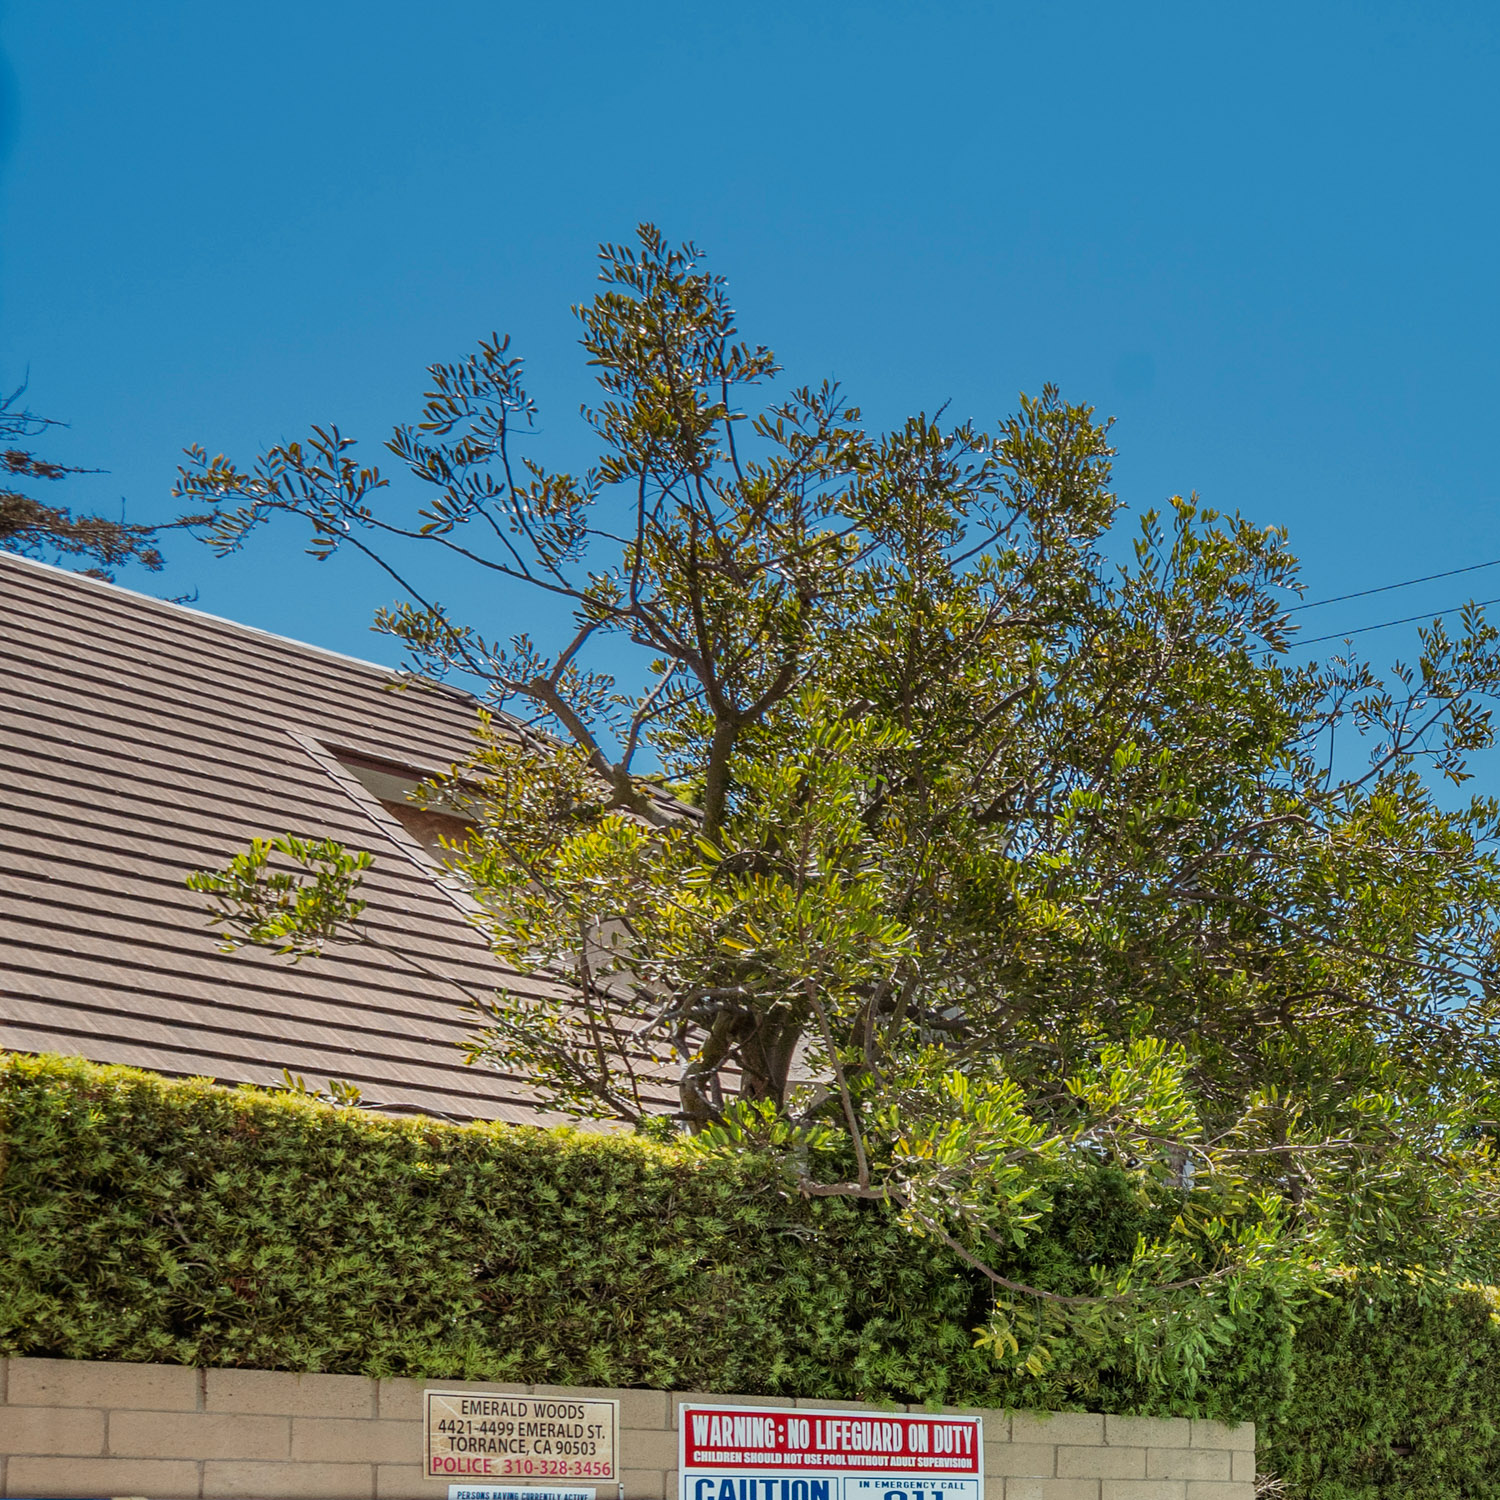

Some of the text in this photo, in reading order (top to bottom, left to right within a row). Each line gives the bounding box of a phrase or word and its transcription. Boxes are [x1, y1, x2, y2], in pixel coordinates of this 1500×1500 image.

[461, 1399, 585, 1420] EMERALD WOODS
[438, 1419, 606, 1440] 4421-4499 EMERALD ST.
[788, 1419, 809, 1450] NO
[816, 1420, 903, 1452] LIFEGUARD
[908, 1423, 929, 1453] ON
[933, 1425, 974, 1454] DUTY
[448, 1436, 596, 1456] TORRANCE, CA 90503
[432, 1457, 611, 1476] POLICE 310-328-3456
[693, 1451, 972, 1468] CHILDREN SHOULD NOT USE POOL WITHOUT ADULT SUPERVISION
[875, 1481, 936, 1489] EMERGENCY
[941, 1482, 966, 1490] CALL
[457, 1491, 490, 1500] PERSONS
[493, 1492, 519, 1500] HAVING
[521, 1493, 561, 1500] CURRENTLY
